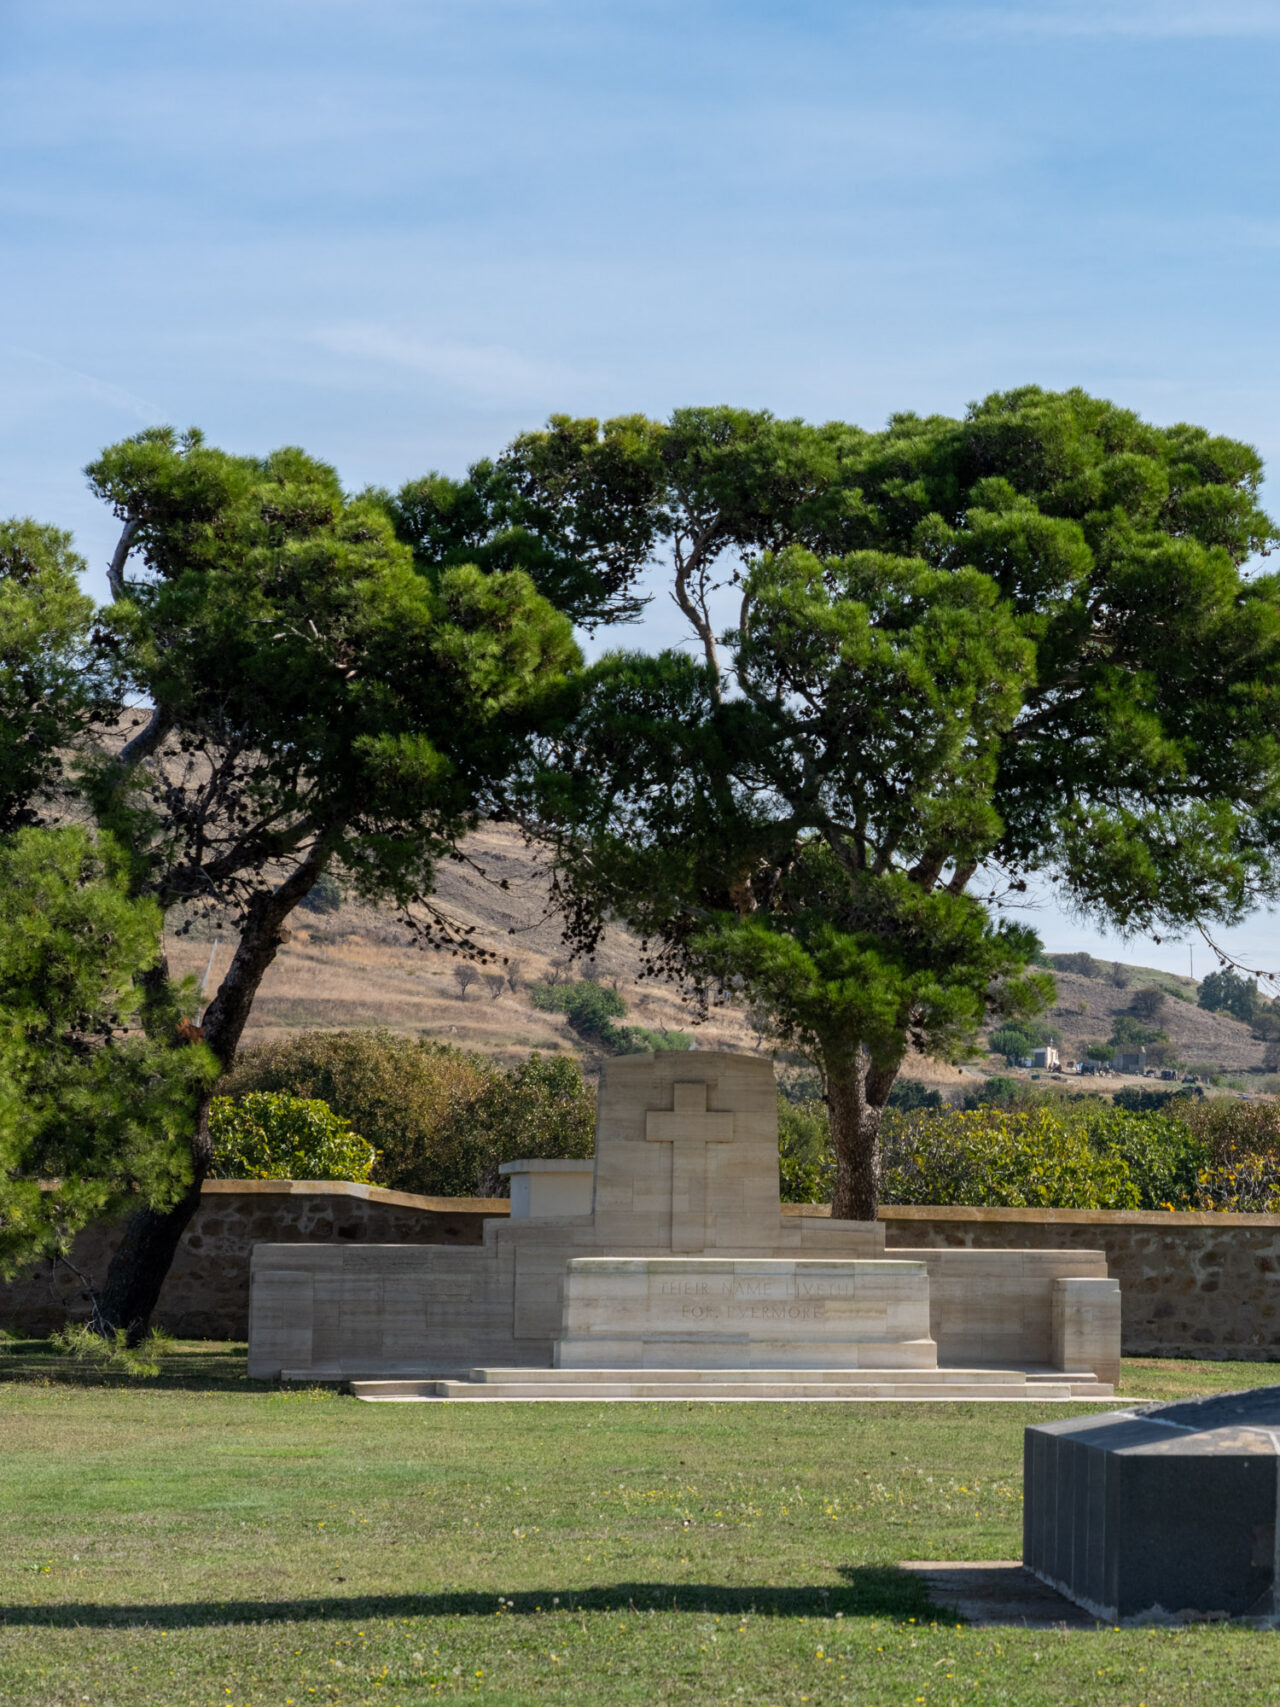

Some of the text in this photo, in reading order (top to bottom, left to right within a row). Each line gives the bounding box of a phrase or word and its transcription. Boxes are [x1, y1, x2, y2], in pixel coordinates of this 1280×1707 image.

[660, 1280, 850, 1297] THEIR NAME LIVETH
[727, 1304, 825, 1320] EVERMORE
